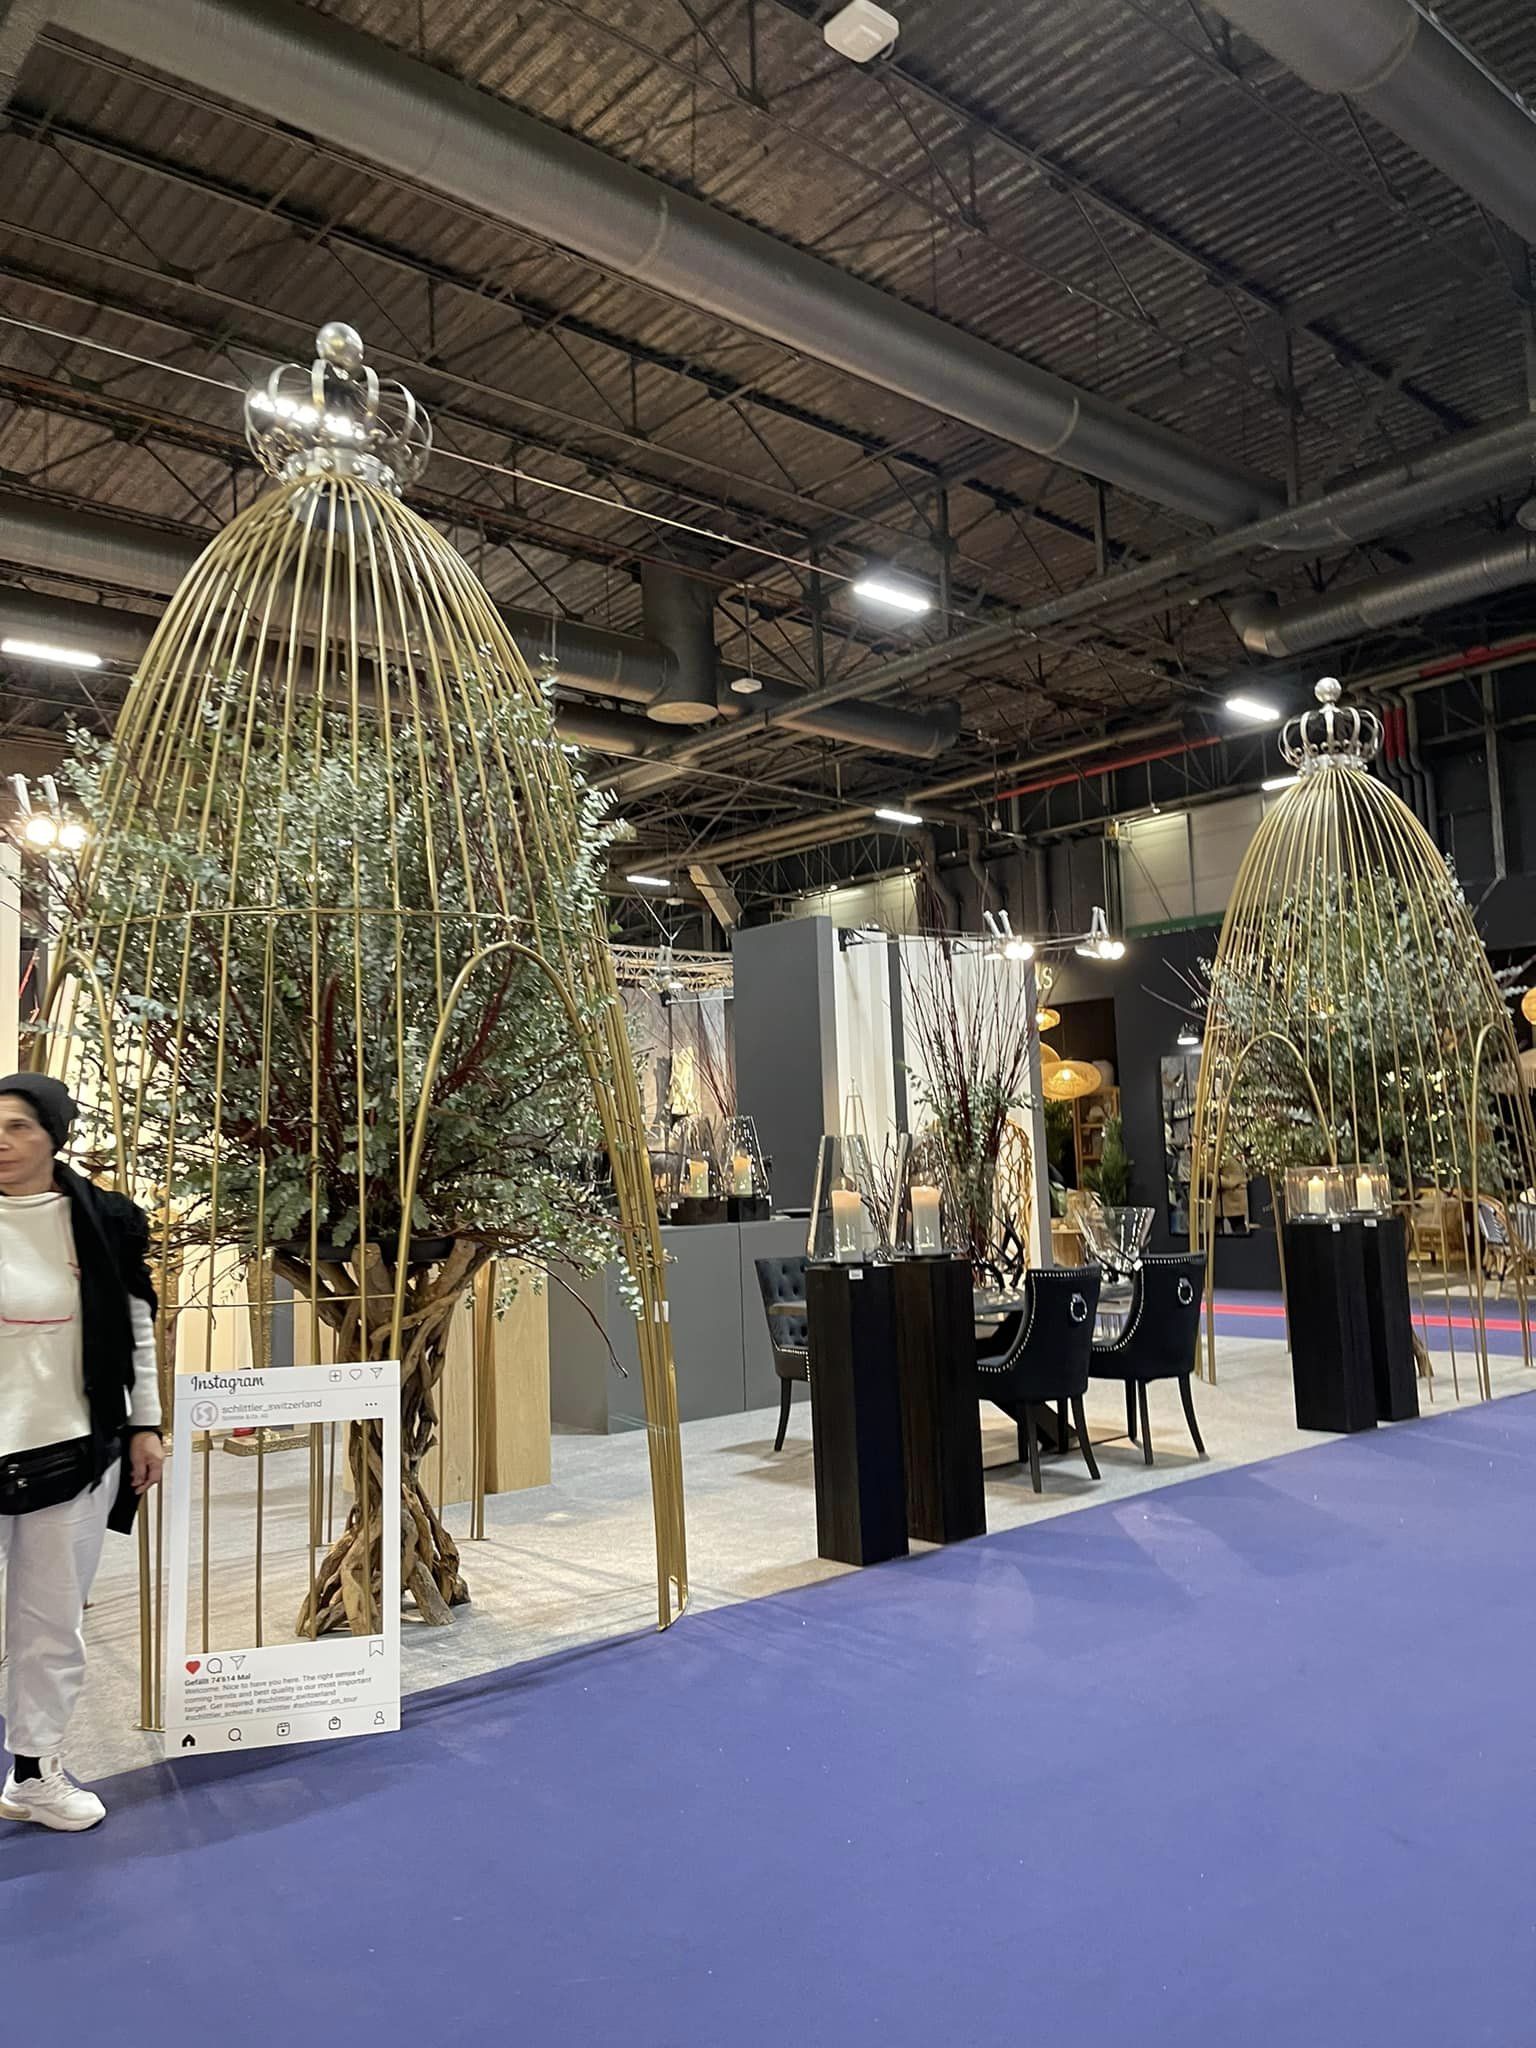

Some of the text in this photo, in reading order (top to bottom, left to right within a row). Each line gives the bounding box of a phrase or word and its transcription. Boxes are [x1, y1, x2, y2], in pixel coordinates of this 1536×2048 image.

[191, 1375, 264, 1394] Instagram
[222, 1400, 322, 1414] schlittler_switzerland
[237, 1673, 251, 1681] Mal
[271, 1686, 294, 1694] quality
[337, 1677, 371, 1686] important
